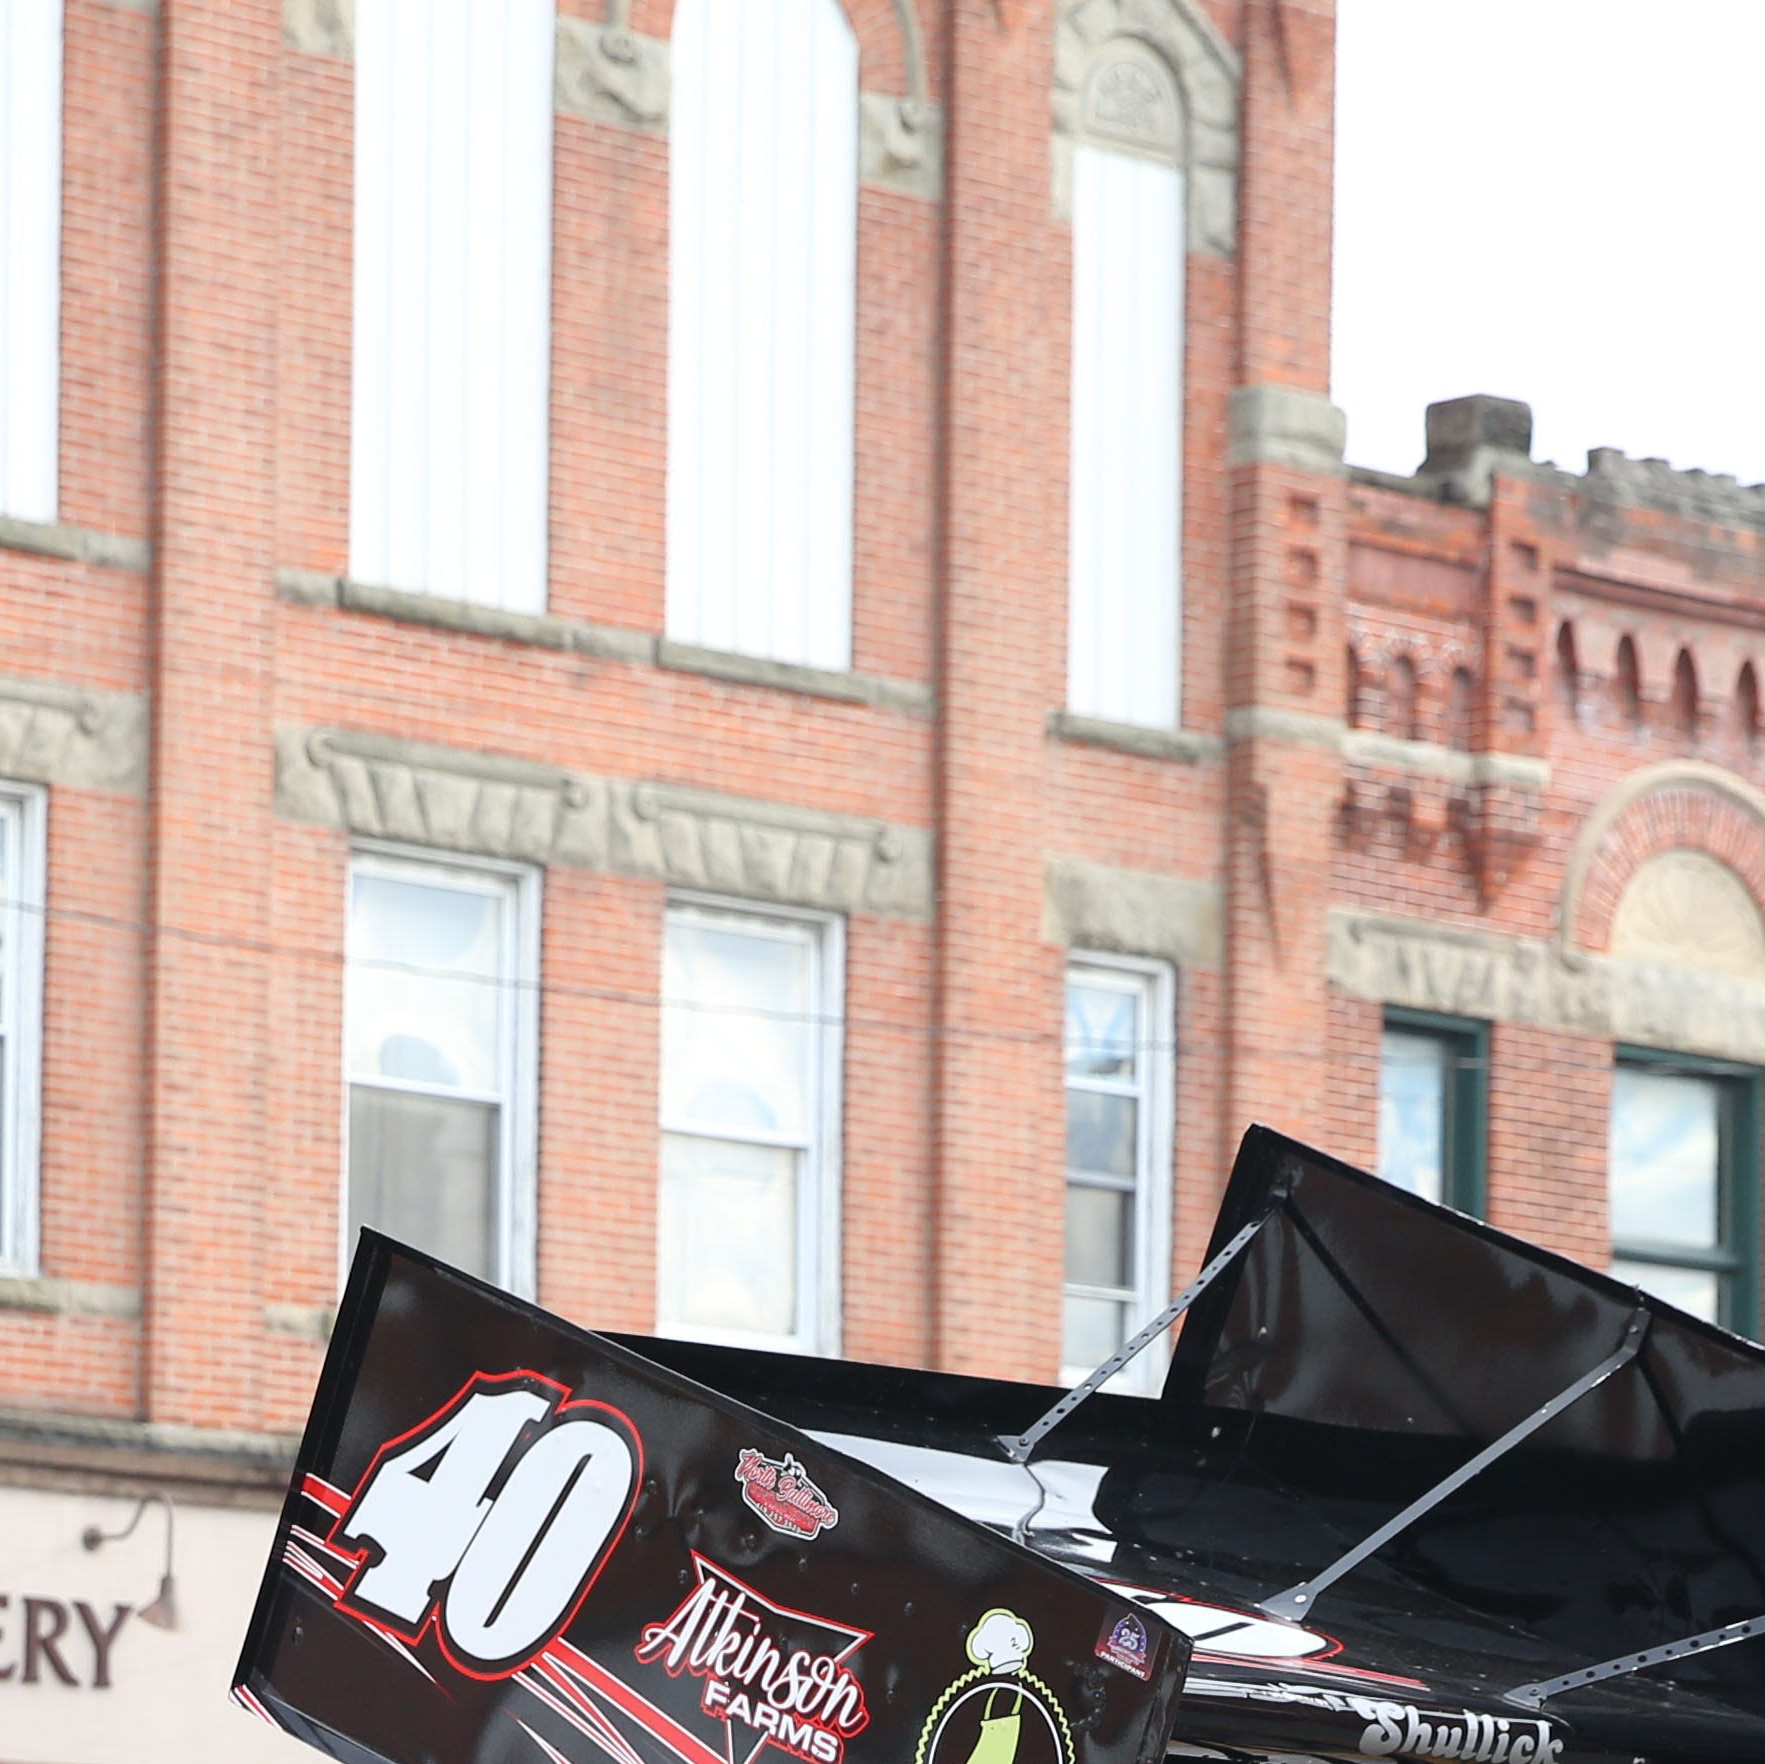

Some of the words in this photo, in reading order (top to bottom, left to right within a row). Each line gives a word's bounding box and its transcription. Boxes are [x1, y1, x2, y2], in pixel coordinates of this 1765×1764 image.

[342, 1386, 638, 1666] 40
[737, 1452, 776, 1490] North
[778, 1475, 836, 1525] Baltimore
[638, 1578, 863, 1728] Atkinson
[1118, 1628, 1140, 1651] 25
[705, 1680, 838, 1763] FARMS
